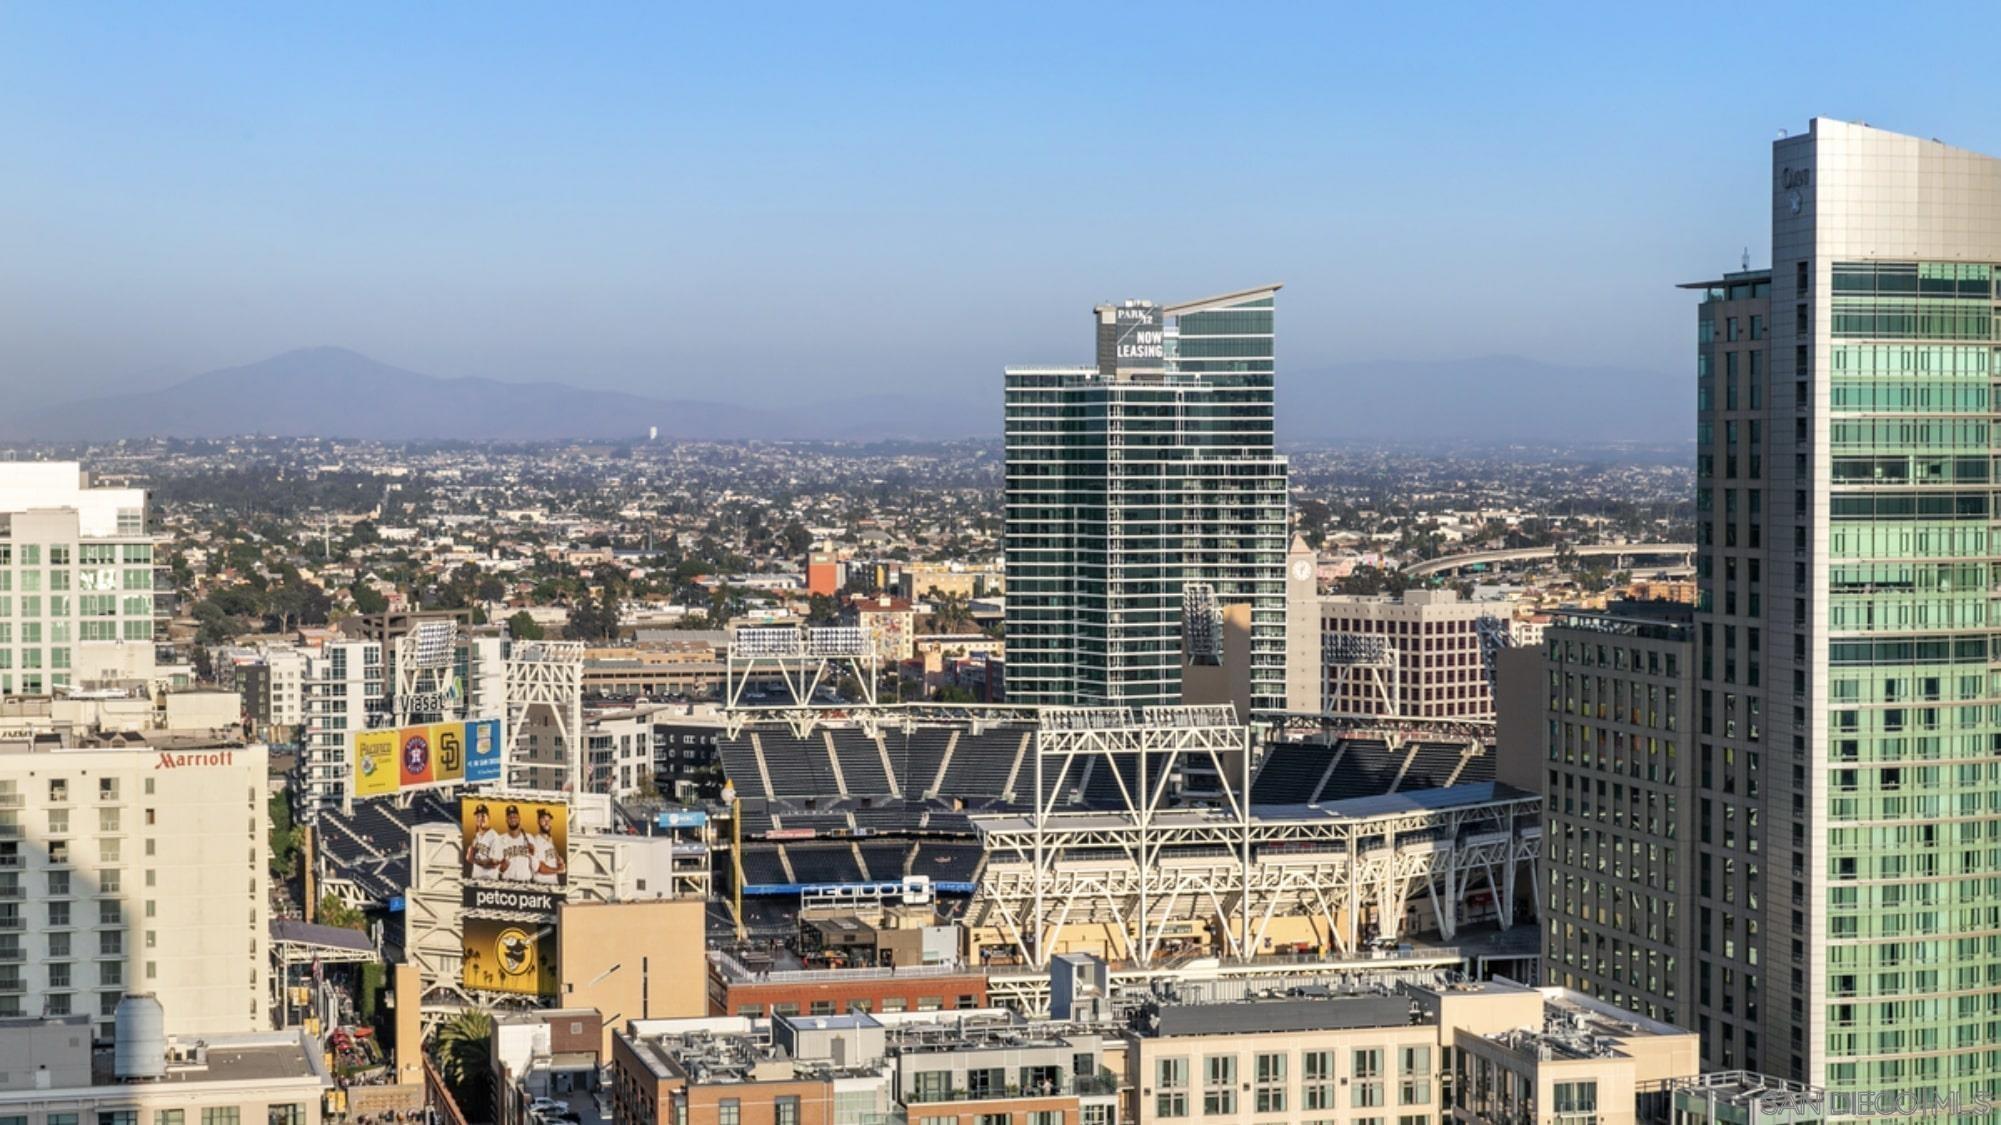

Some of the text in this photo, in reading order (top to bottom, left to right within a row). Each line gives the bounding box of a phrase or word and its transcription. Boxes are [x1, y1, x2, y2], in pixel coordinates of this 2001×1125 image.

[1118, 309, 1145, 319] PARK
[1137, 331, 1162, 345] NOW
[1117, 345, 1163, 358] LEASING
[155, 752, 233, 769] Marriott
[476, 890, 552, 909] petco park
